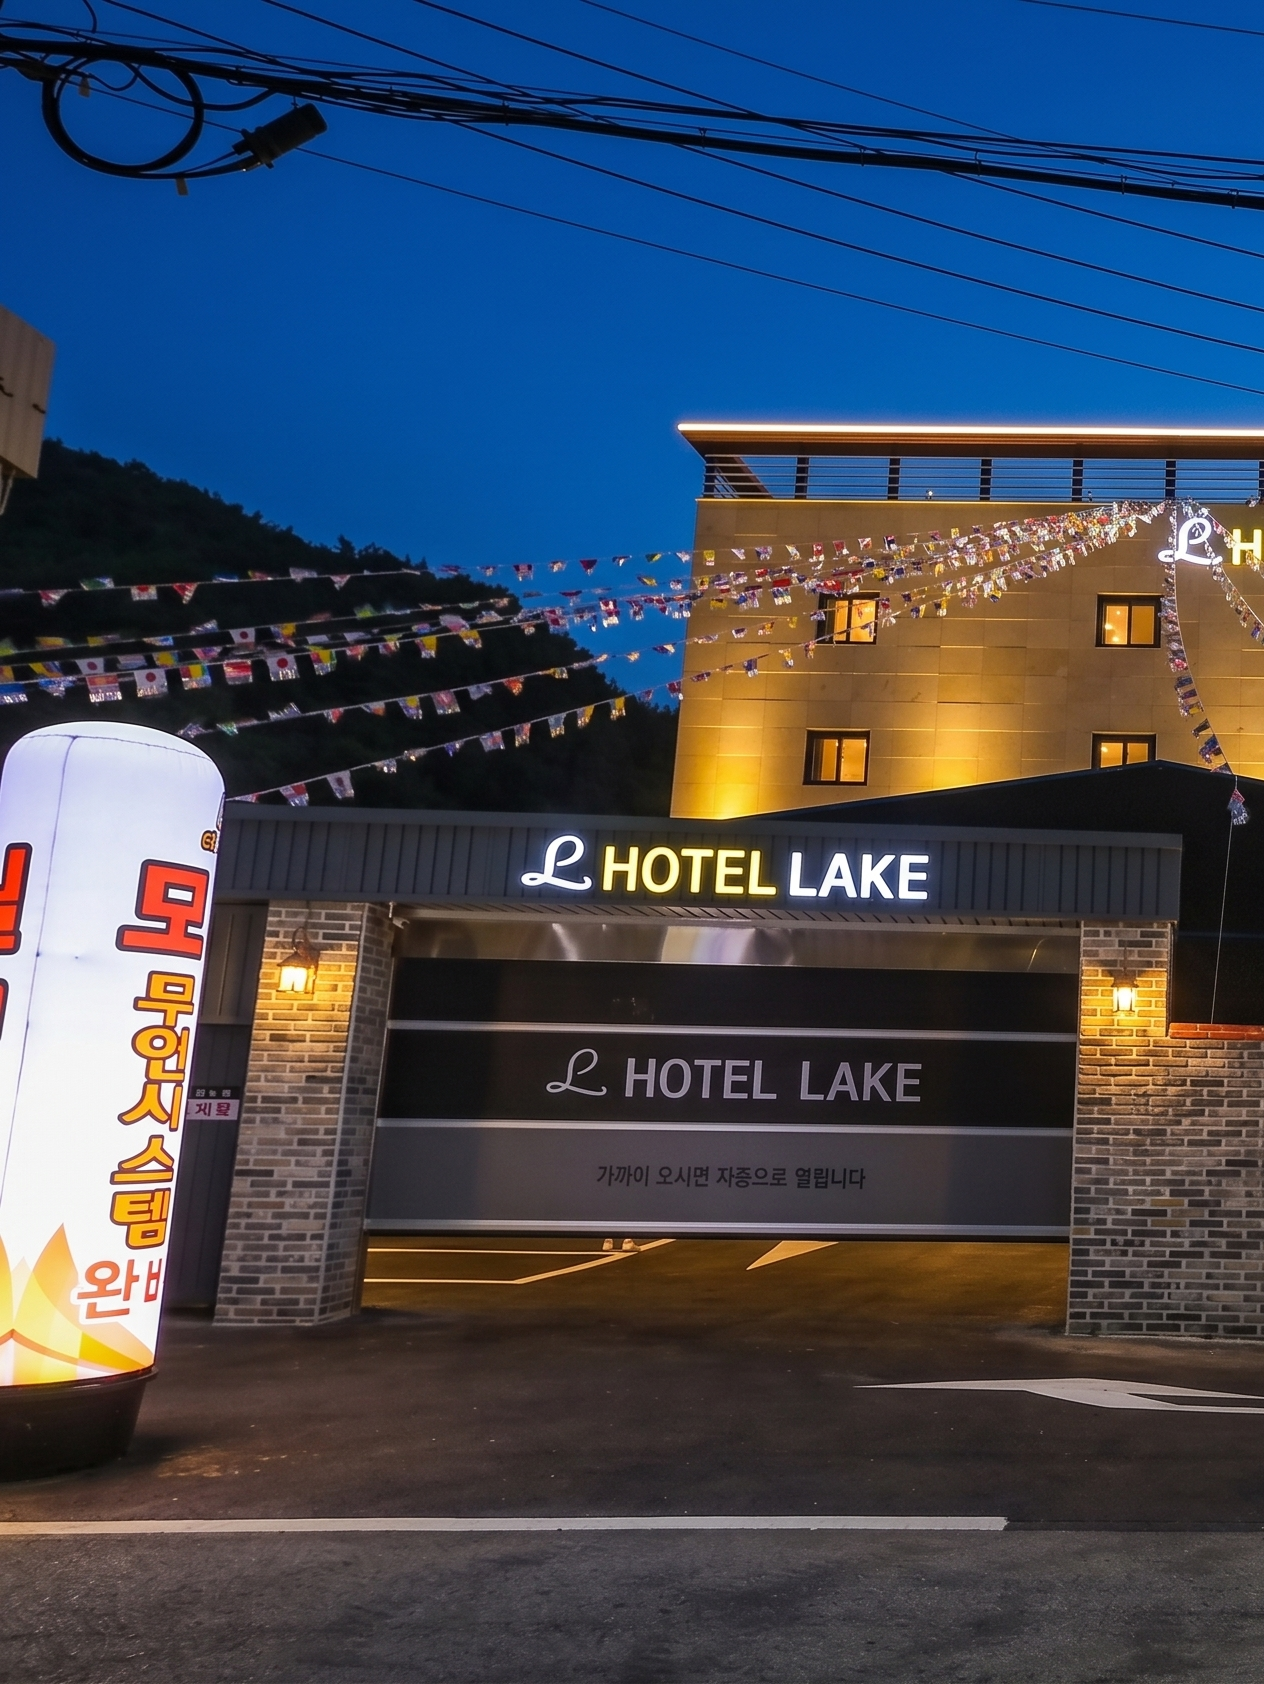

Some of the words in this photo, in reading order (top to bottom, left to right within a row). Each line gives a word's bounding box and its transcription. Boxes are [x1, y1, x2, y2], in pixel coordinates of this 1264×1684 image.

[602, 845, 777, 895] HOTEL
[789, 851, 929, 900] LAKE
[625, 1057, 777, 1100] HOTEL
[799, 1061, 922, 1102] LAKE
[596, 1165, 650, 1187] 가까이
[656, 1166, 709, 1187] 오시면
[795, 1167, 866, 1189] 열립니다
